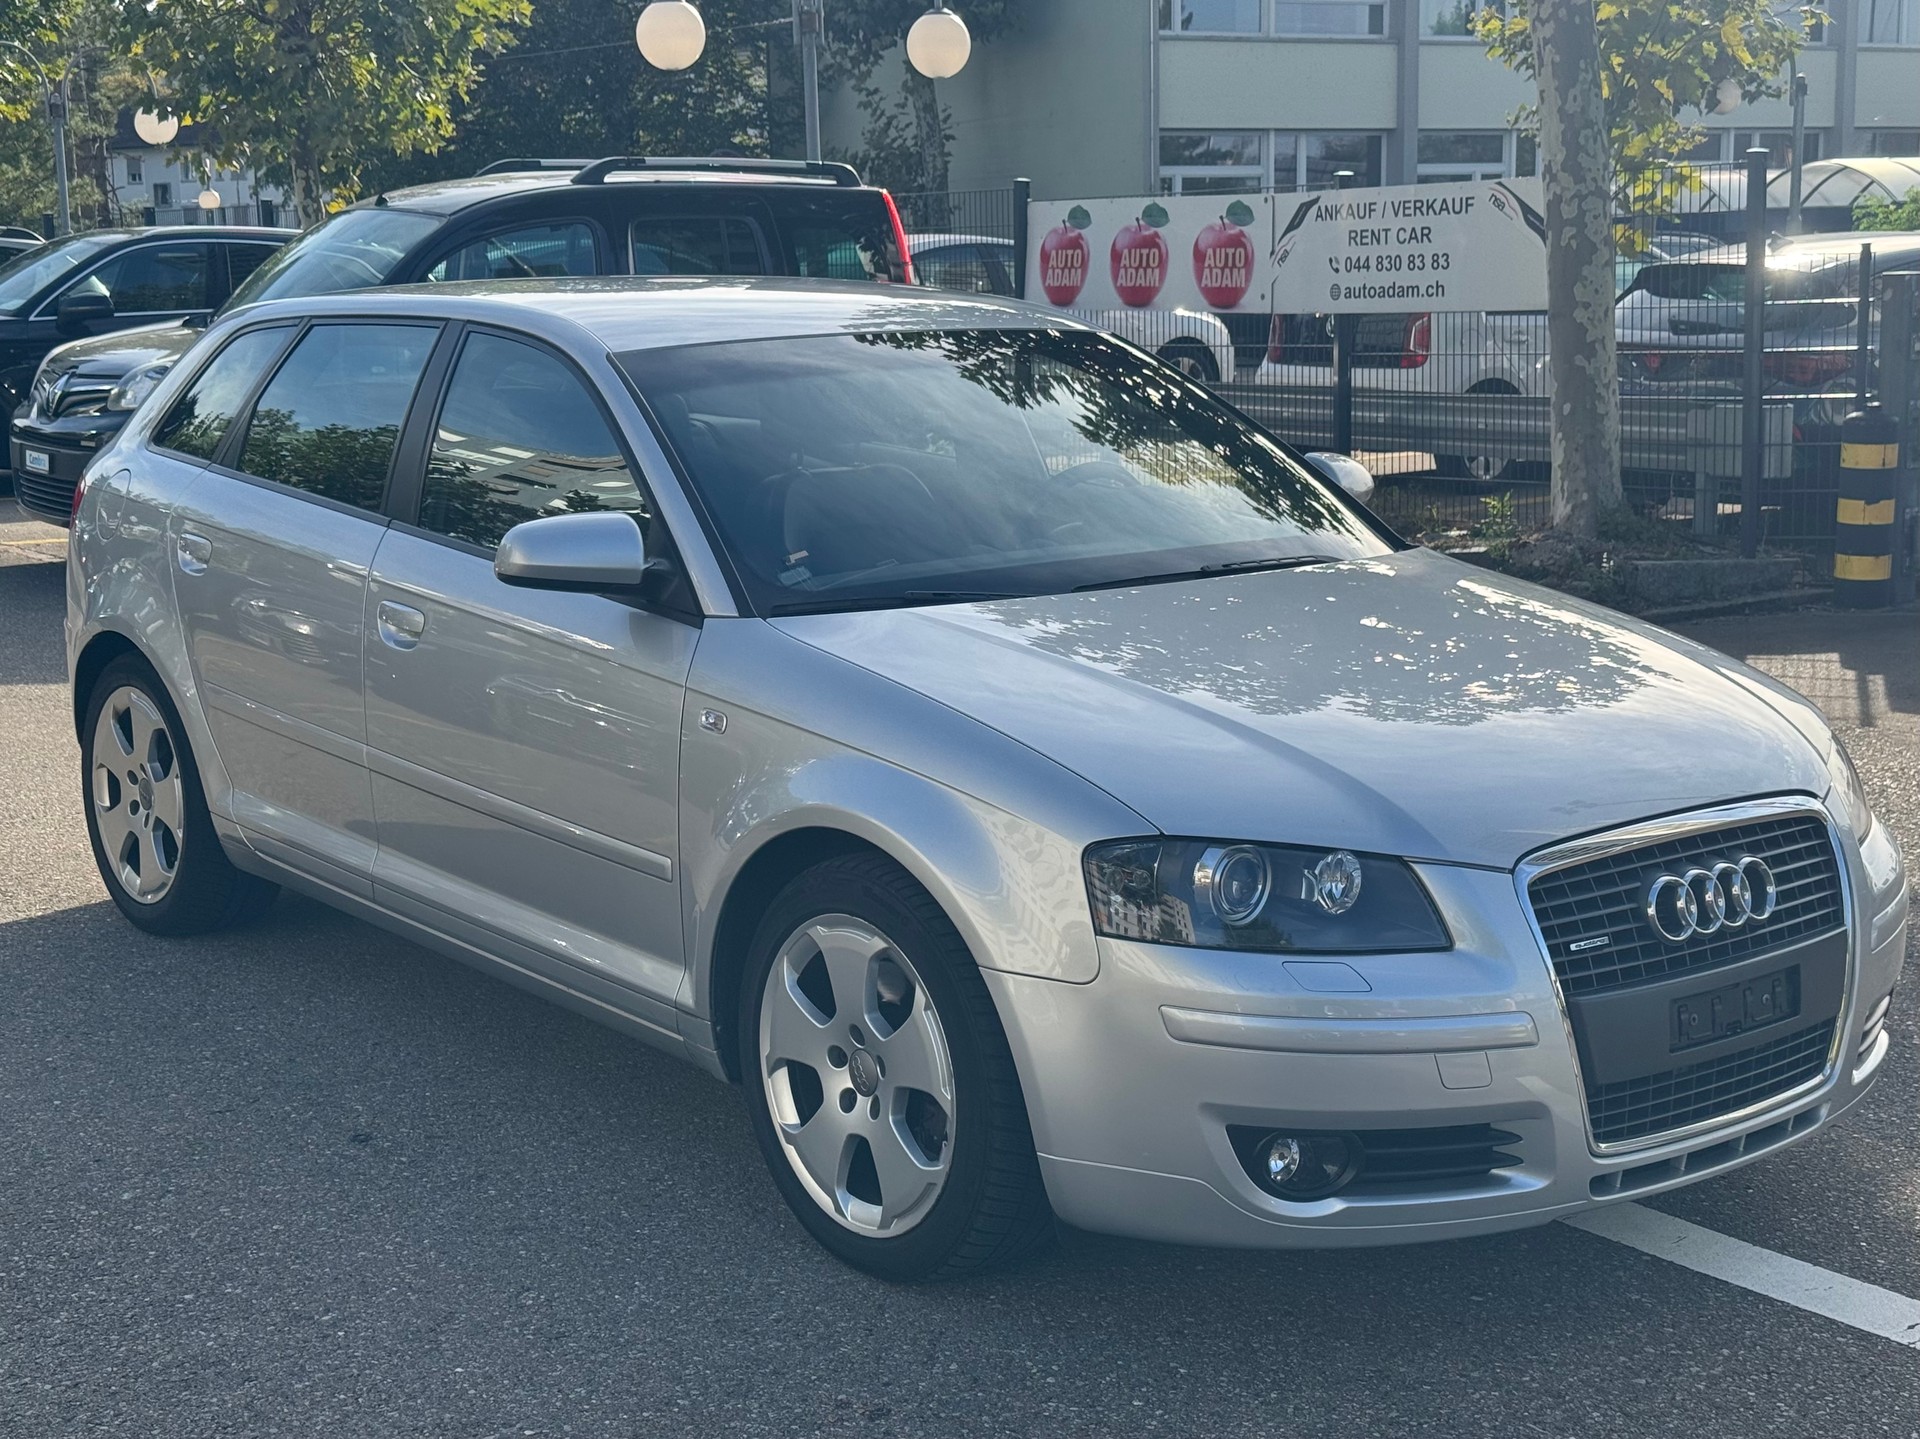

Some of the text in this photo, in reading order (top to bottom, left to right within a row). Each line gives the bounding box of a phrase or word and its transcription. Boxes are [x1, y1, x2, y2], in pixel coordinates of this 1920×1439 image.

[1314, 201, 1377, 222] ANKAUF
[1391, 196, 1475, 218] VERKAUF
[1348, 226, 1432, 246] RENT CAR
[1049, 249, 1082, 268] AUTO
[1120, 248, 1160, 268] AUTO
[1204, 248, 1245, 268] AUTO
[1344, 252, 1450, 273] 044 830 83 83
[1045, 268, 1082, 287] ADAM
[1116, 268, 1160, 287] ADAM
[1201, 268, 1246, 288] ADAM
[1343, 280, 1445, 300] autoadam.ch
